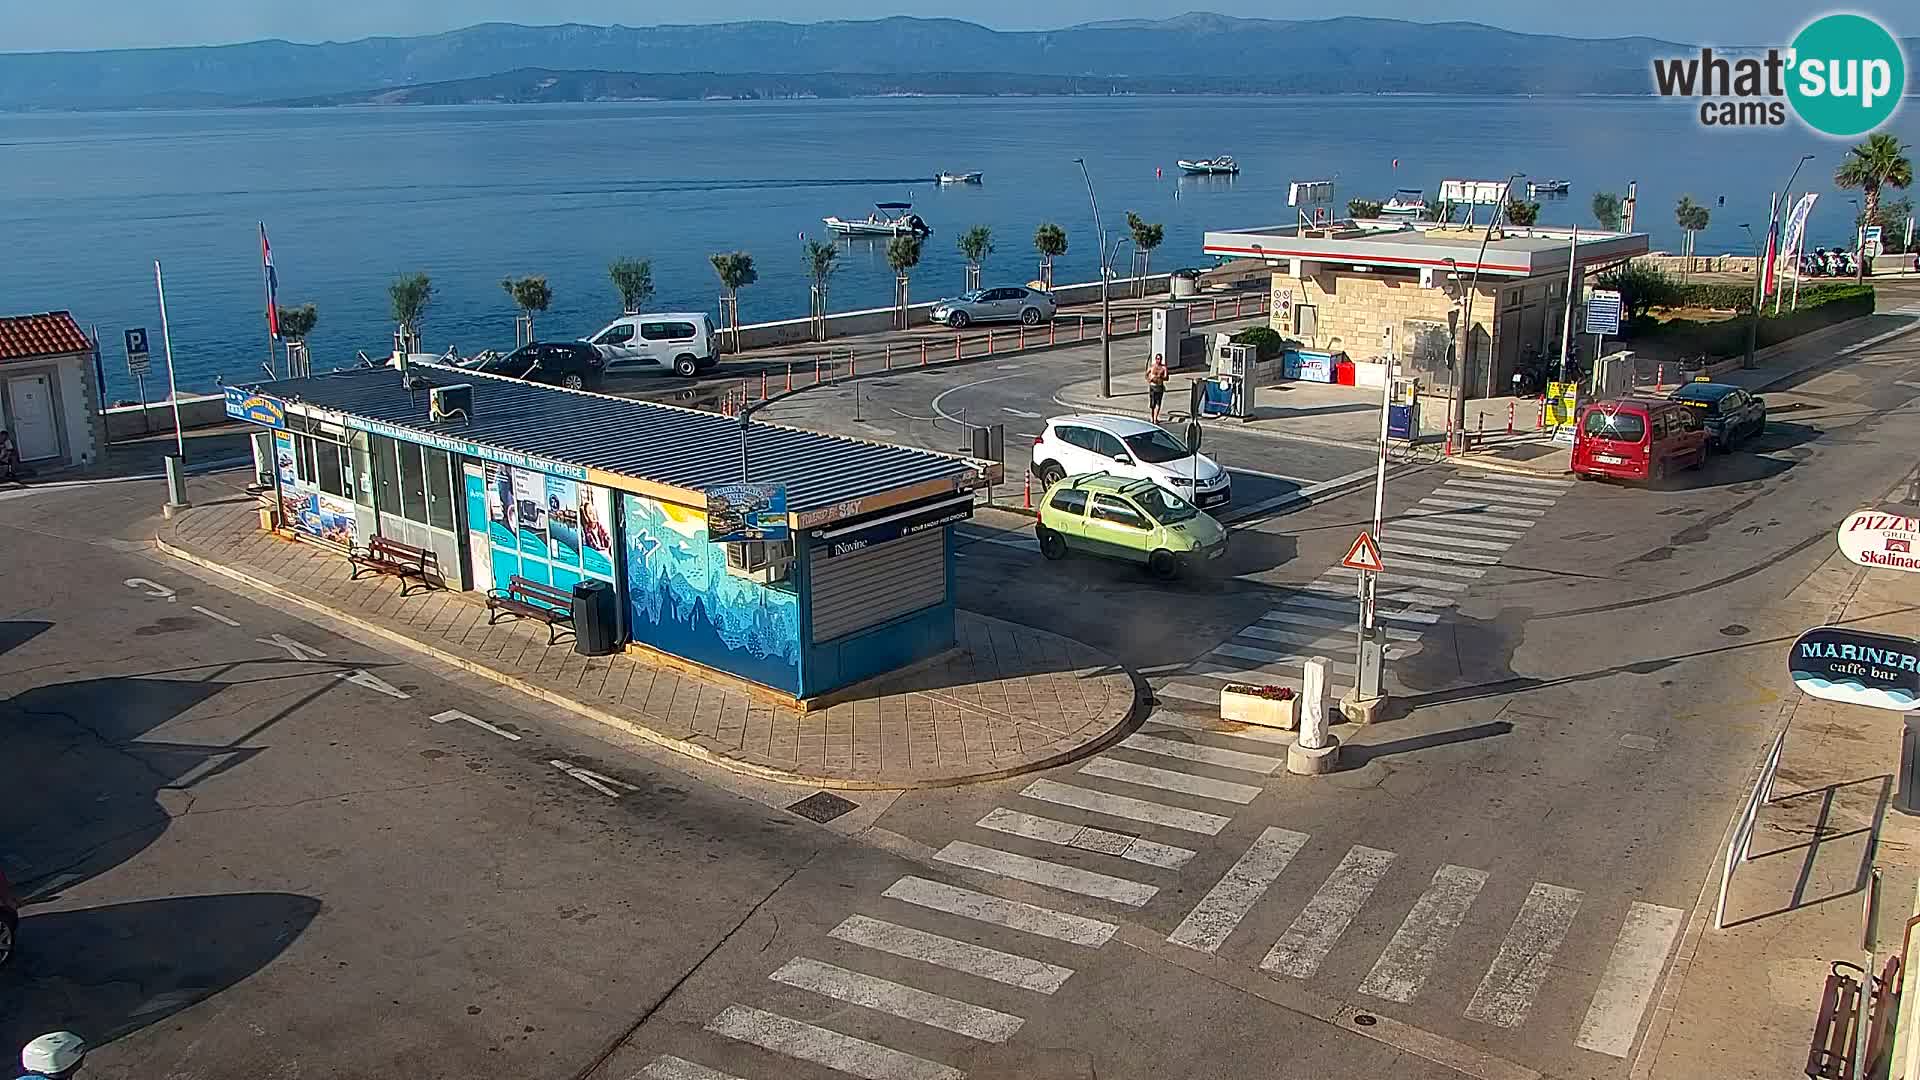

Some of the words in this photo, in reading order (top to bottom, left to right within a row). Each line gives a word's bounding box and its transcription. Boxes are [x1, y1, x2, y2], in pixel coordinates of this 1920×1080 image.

[130, 332, 141, 350] P
[395, 426, 436, 445] AUTOBUSNA
[436, 436, 468, 453] POSTAJA
[478, 446, 493, 460] BUS
[492, 448, 527, 466] STATION
[527, 456, 554, 472] TICKET
[554, 463, 584, 479] OFFICE
[1848, 515, 1920, 533] PIZZE
[1882, 530, 1917, 541] GRILL
[1830, 662, 1867, 676] caffe
[1871, 666, 1899, 681] bar
